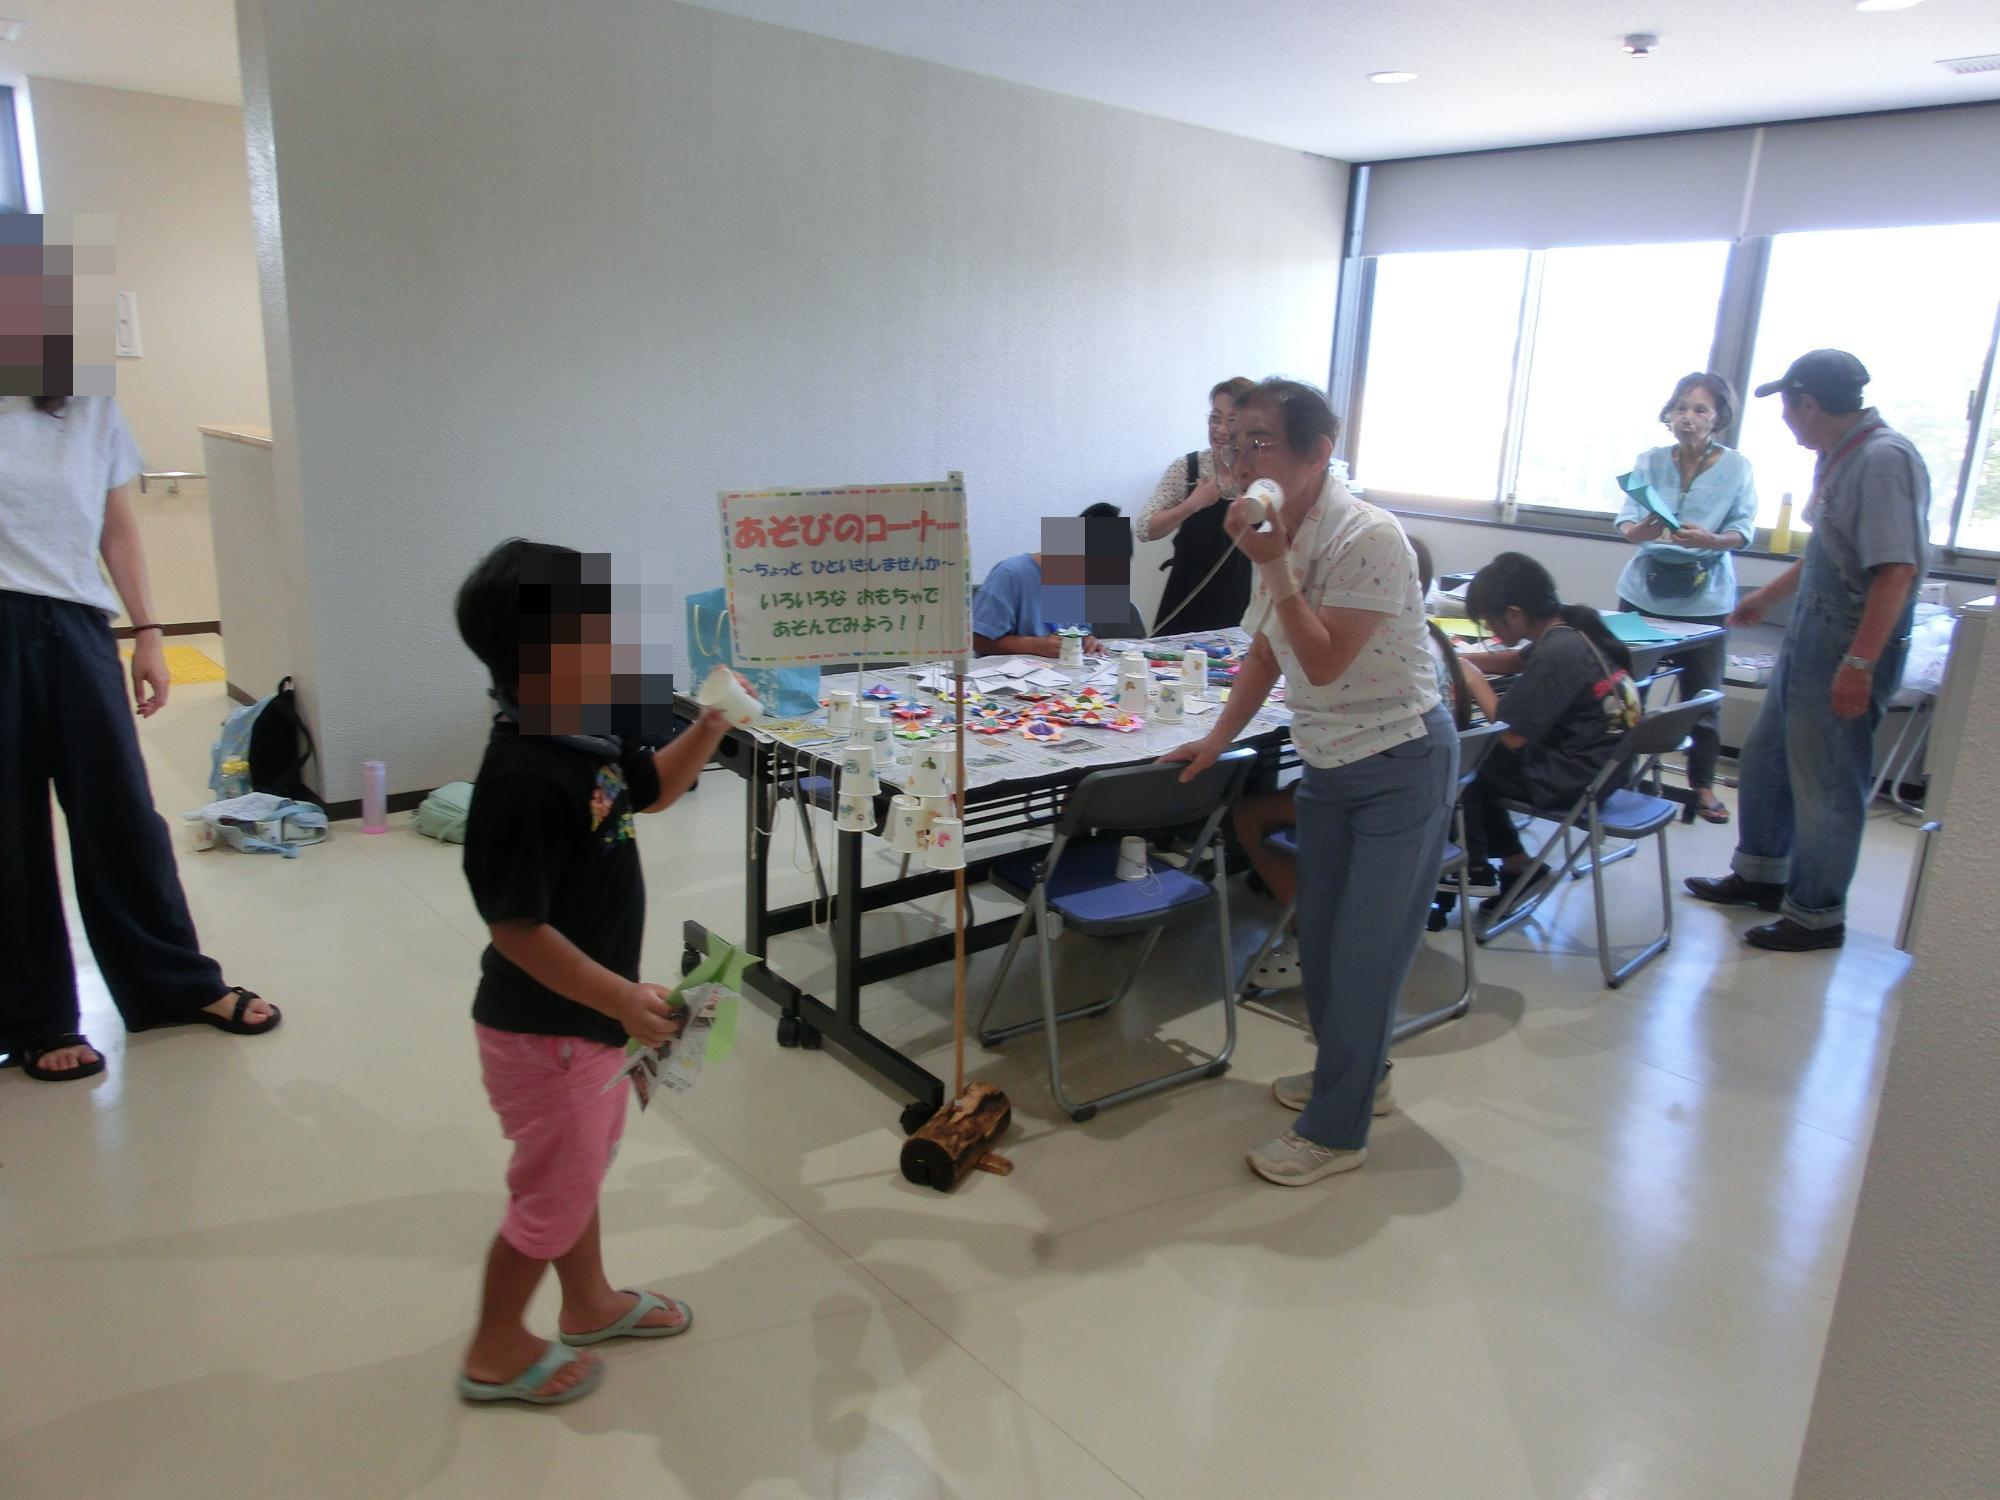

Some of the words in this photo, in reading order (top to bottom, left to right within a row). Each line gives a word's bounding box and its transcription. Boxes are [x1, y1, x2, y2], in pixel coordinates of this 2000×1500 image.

[735, 510, 960, 549] あそびのコーナー
[760, 589, 847, 610] いろいろな
[857, 586, 939, 606] おもちゃで
